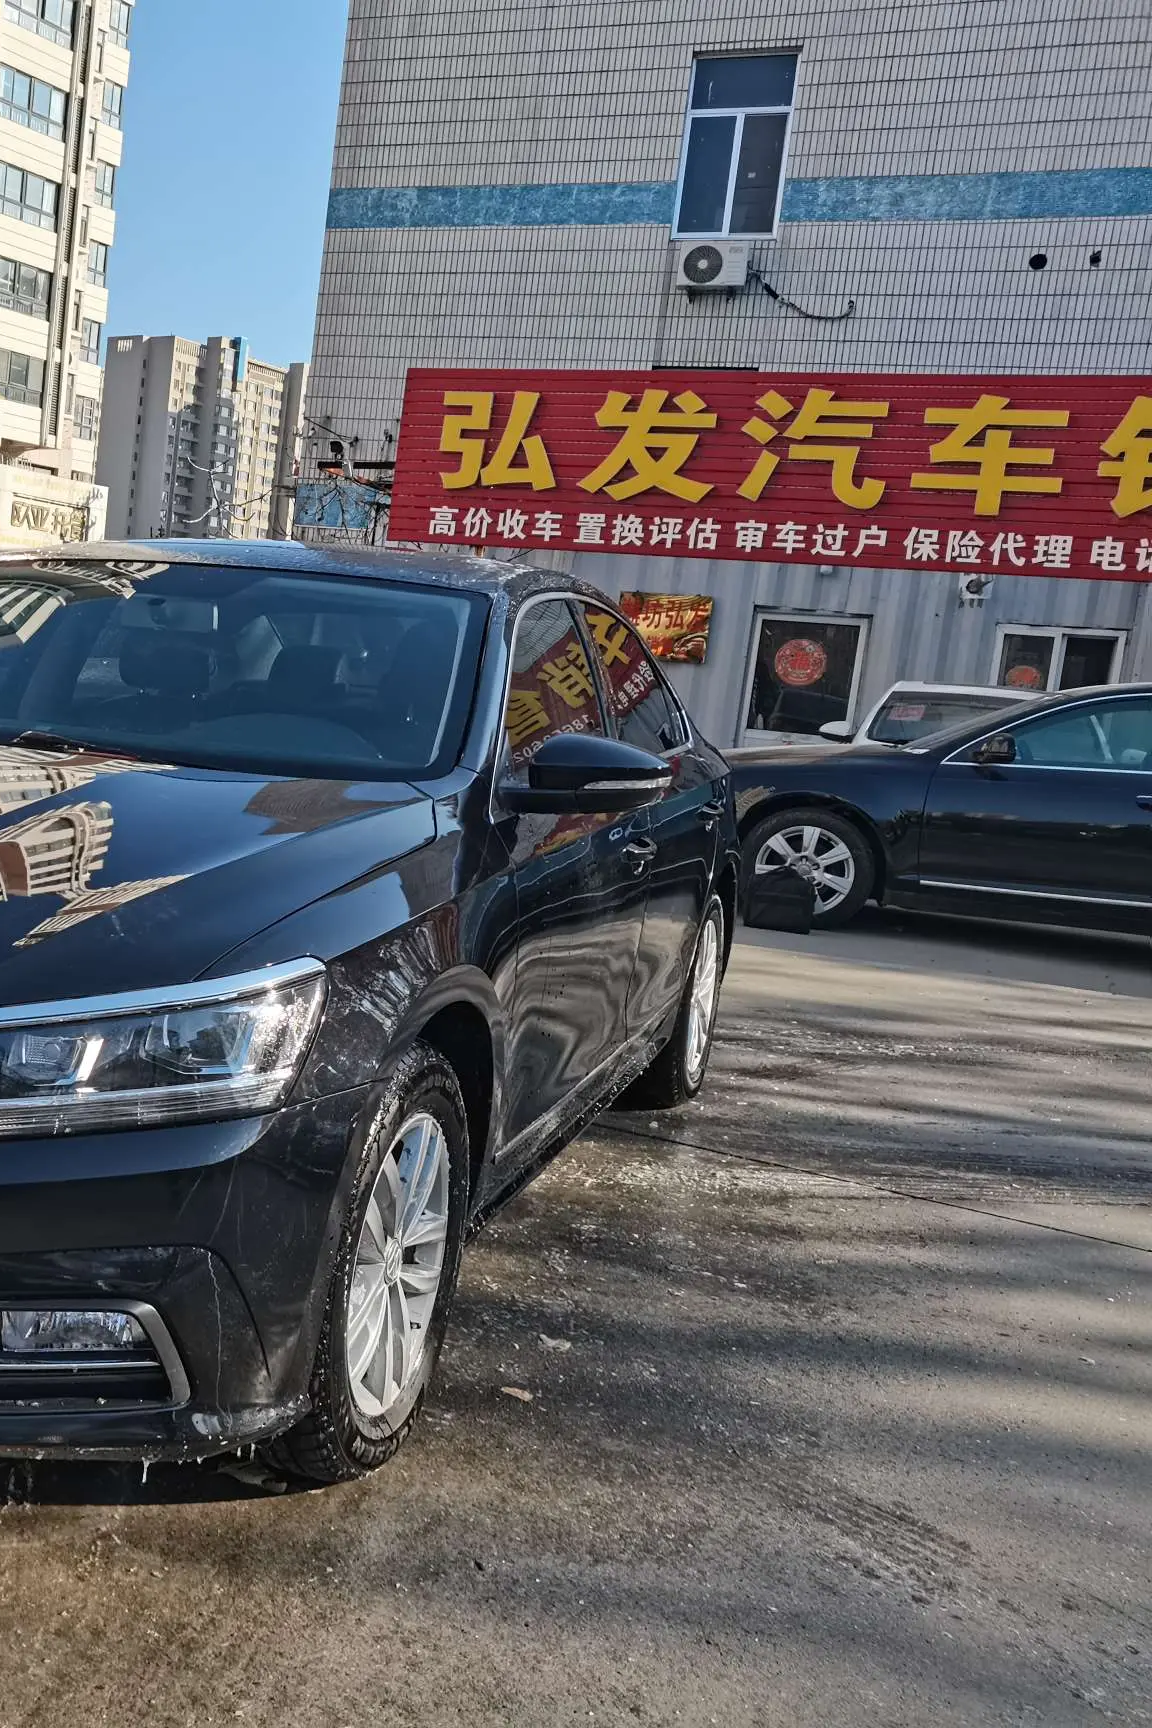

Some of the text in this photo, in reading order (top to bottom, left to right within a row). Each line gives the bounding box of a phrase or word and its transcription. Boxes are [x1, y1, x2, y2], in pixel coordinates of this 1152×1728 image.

[428, 507, 1152, 573] 高价收车 置换评估 审车过户 保险代理 电
